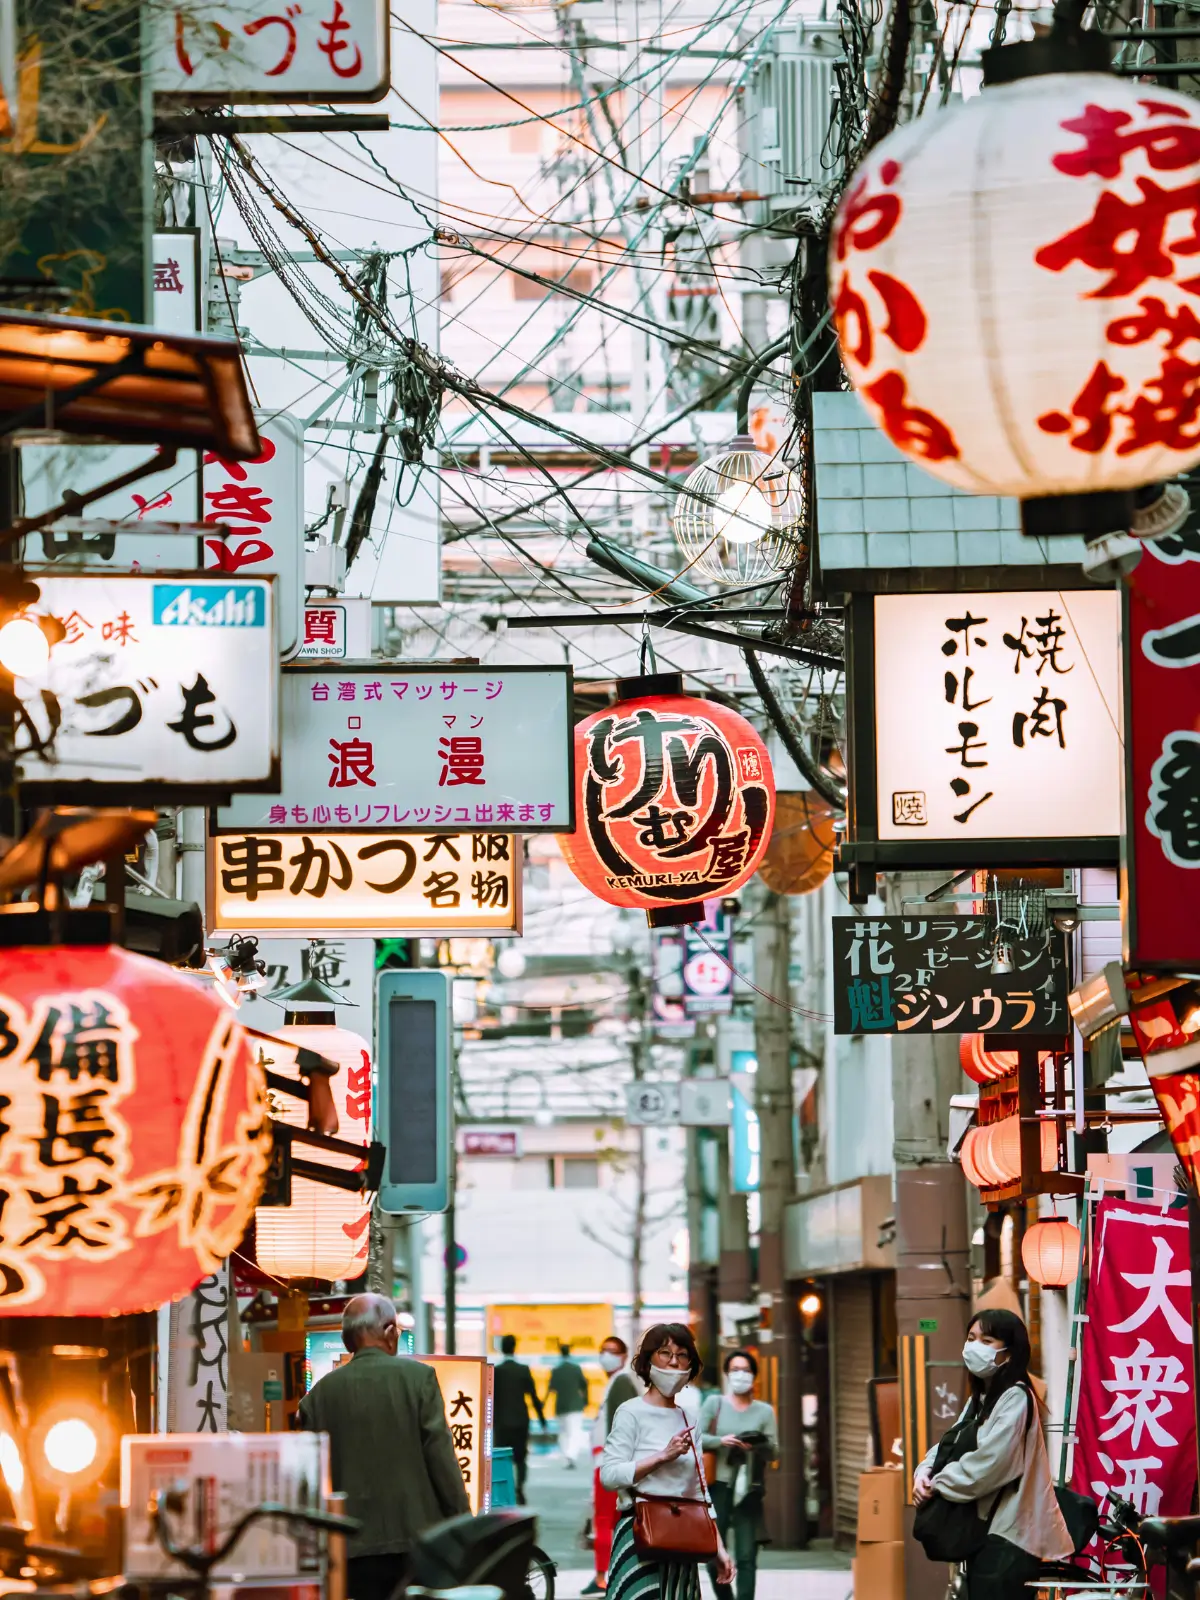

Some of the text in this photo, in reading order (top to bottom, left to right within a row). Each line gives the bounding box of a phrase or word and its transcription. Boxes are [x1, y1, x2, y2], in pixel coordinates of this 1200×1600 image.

[174, 0, 362, 78] いづも
[160, 587, 256, 626] Asahi
[303, 610, 336, 644] 質
[299, 647, 343, 655] AWN SHOP
[311, 681, 504, 701] 台湾式マッサージ
[1003, 609, 1075, 750] 焼肉
[941, 611, 994, 824] ホルモン
[328, 737, 486, 788] 浪漫
[269, 803, 556, 824] 身も心もリフレッシュ出来ます
[220, 836, 418, 902] 串かつ
[606, 870, 701, 888] KEMURI-YA
[422, 870, 509, 908] 名物
[923, 946, 1044, 971] ゼーシン
[894, 968, 935, 992] 2F
[896, 988, 1037, 1032] ジンウラ
[1089, 1236, 1194, 1592] 大衆酒
